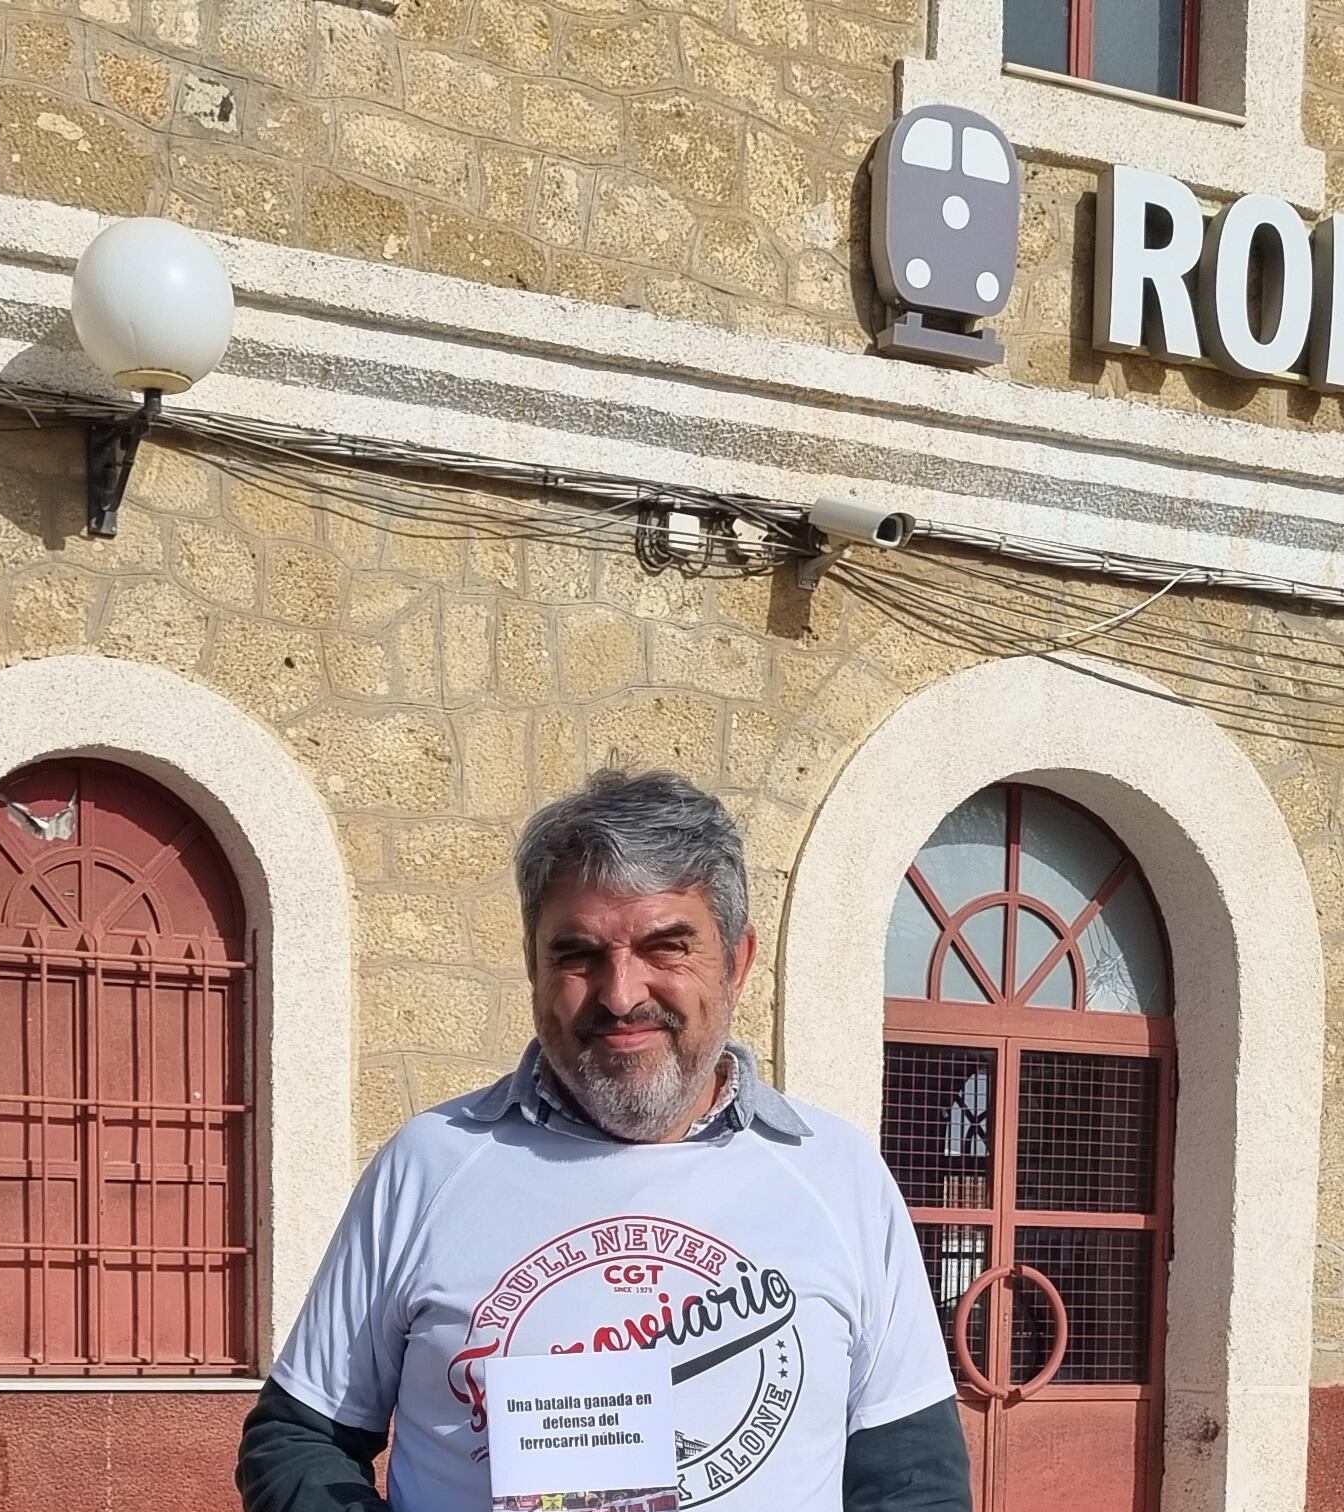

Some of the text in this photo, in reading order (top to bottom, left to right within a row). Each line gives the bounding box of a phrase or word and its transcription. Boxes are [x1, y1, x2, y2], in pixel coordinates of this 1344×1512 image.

[592, 1223, 728, 1277] NEVER
[603, 1264, 664, 1285] CGT
[506, 1393, 653, 1413] Una batalla ganada en
[542, 1412, 620, 1430] defensa del
[519, 1431, 645, 1451] ferrocarril público.
[704, 1382, 793, 1491] ALONE
